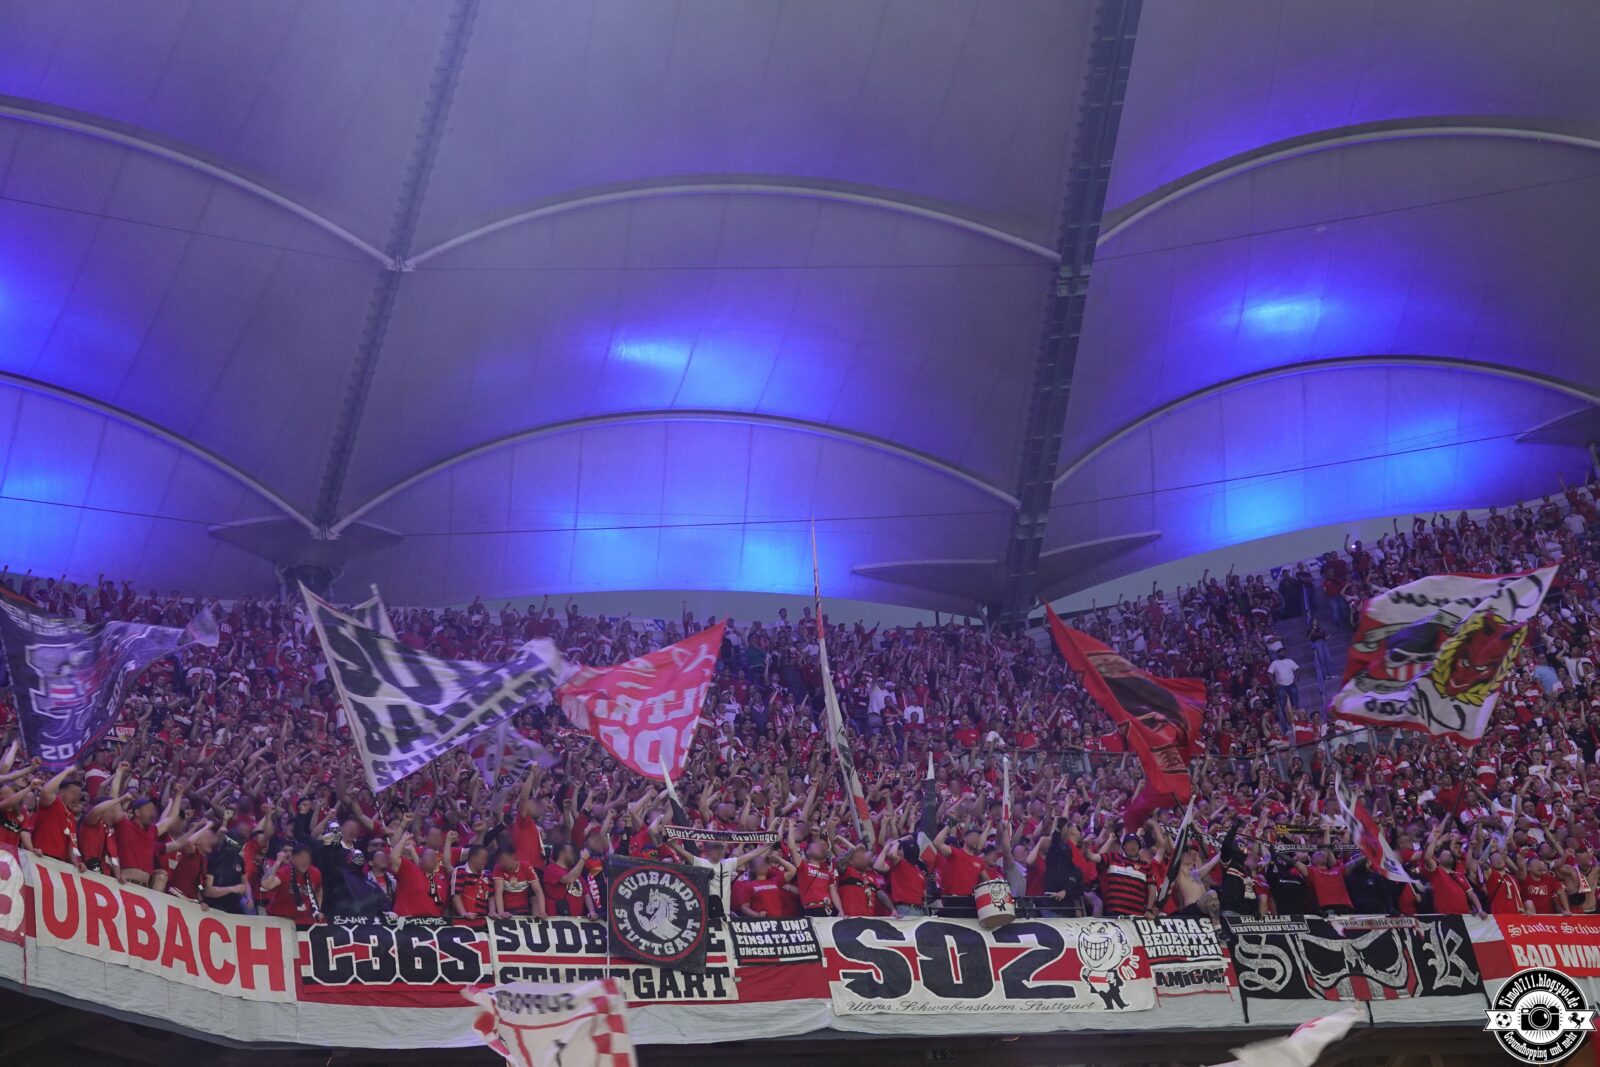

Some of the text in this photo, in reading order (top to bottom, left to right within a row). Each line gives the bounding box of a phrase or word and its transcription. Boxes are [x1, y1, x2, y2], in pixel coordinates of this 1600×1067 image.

[618, 872, 699, 911] SÜDBANDE
[36, 863, 287, 991] URBACH
[614, 908, 701, 956] STUTTGART
[732, 918, 809, 933] KAMPF UND
[1136, 918, 1214, 935] ULTRAS
[736, 930, 814, 945] EINSATZ FÜR
[1142, 932, 1218, 947] BEDEUTET
[739, 944, 816, 956] UNSERE FARBEN!
[1511, 944, 1557, 967] BAD
[847, 1000, 1095, 1013] Ultras Schwabensturm Stuttgart
